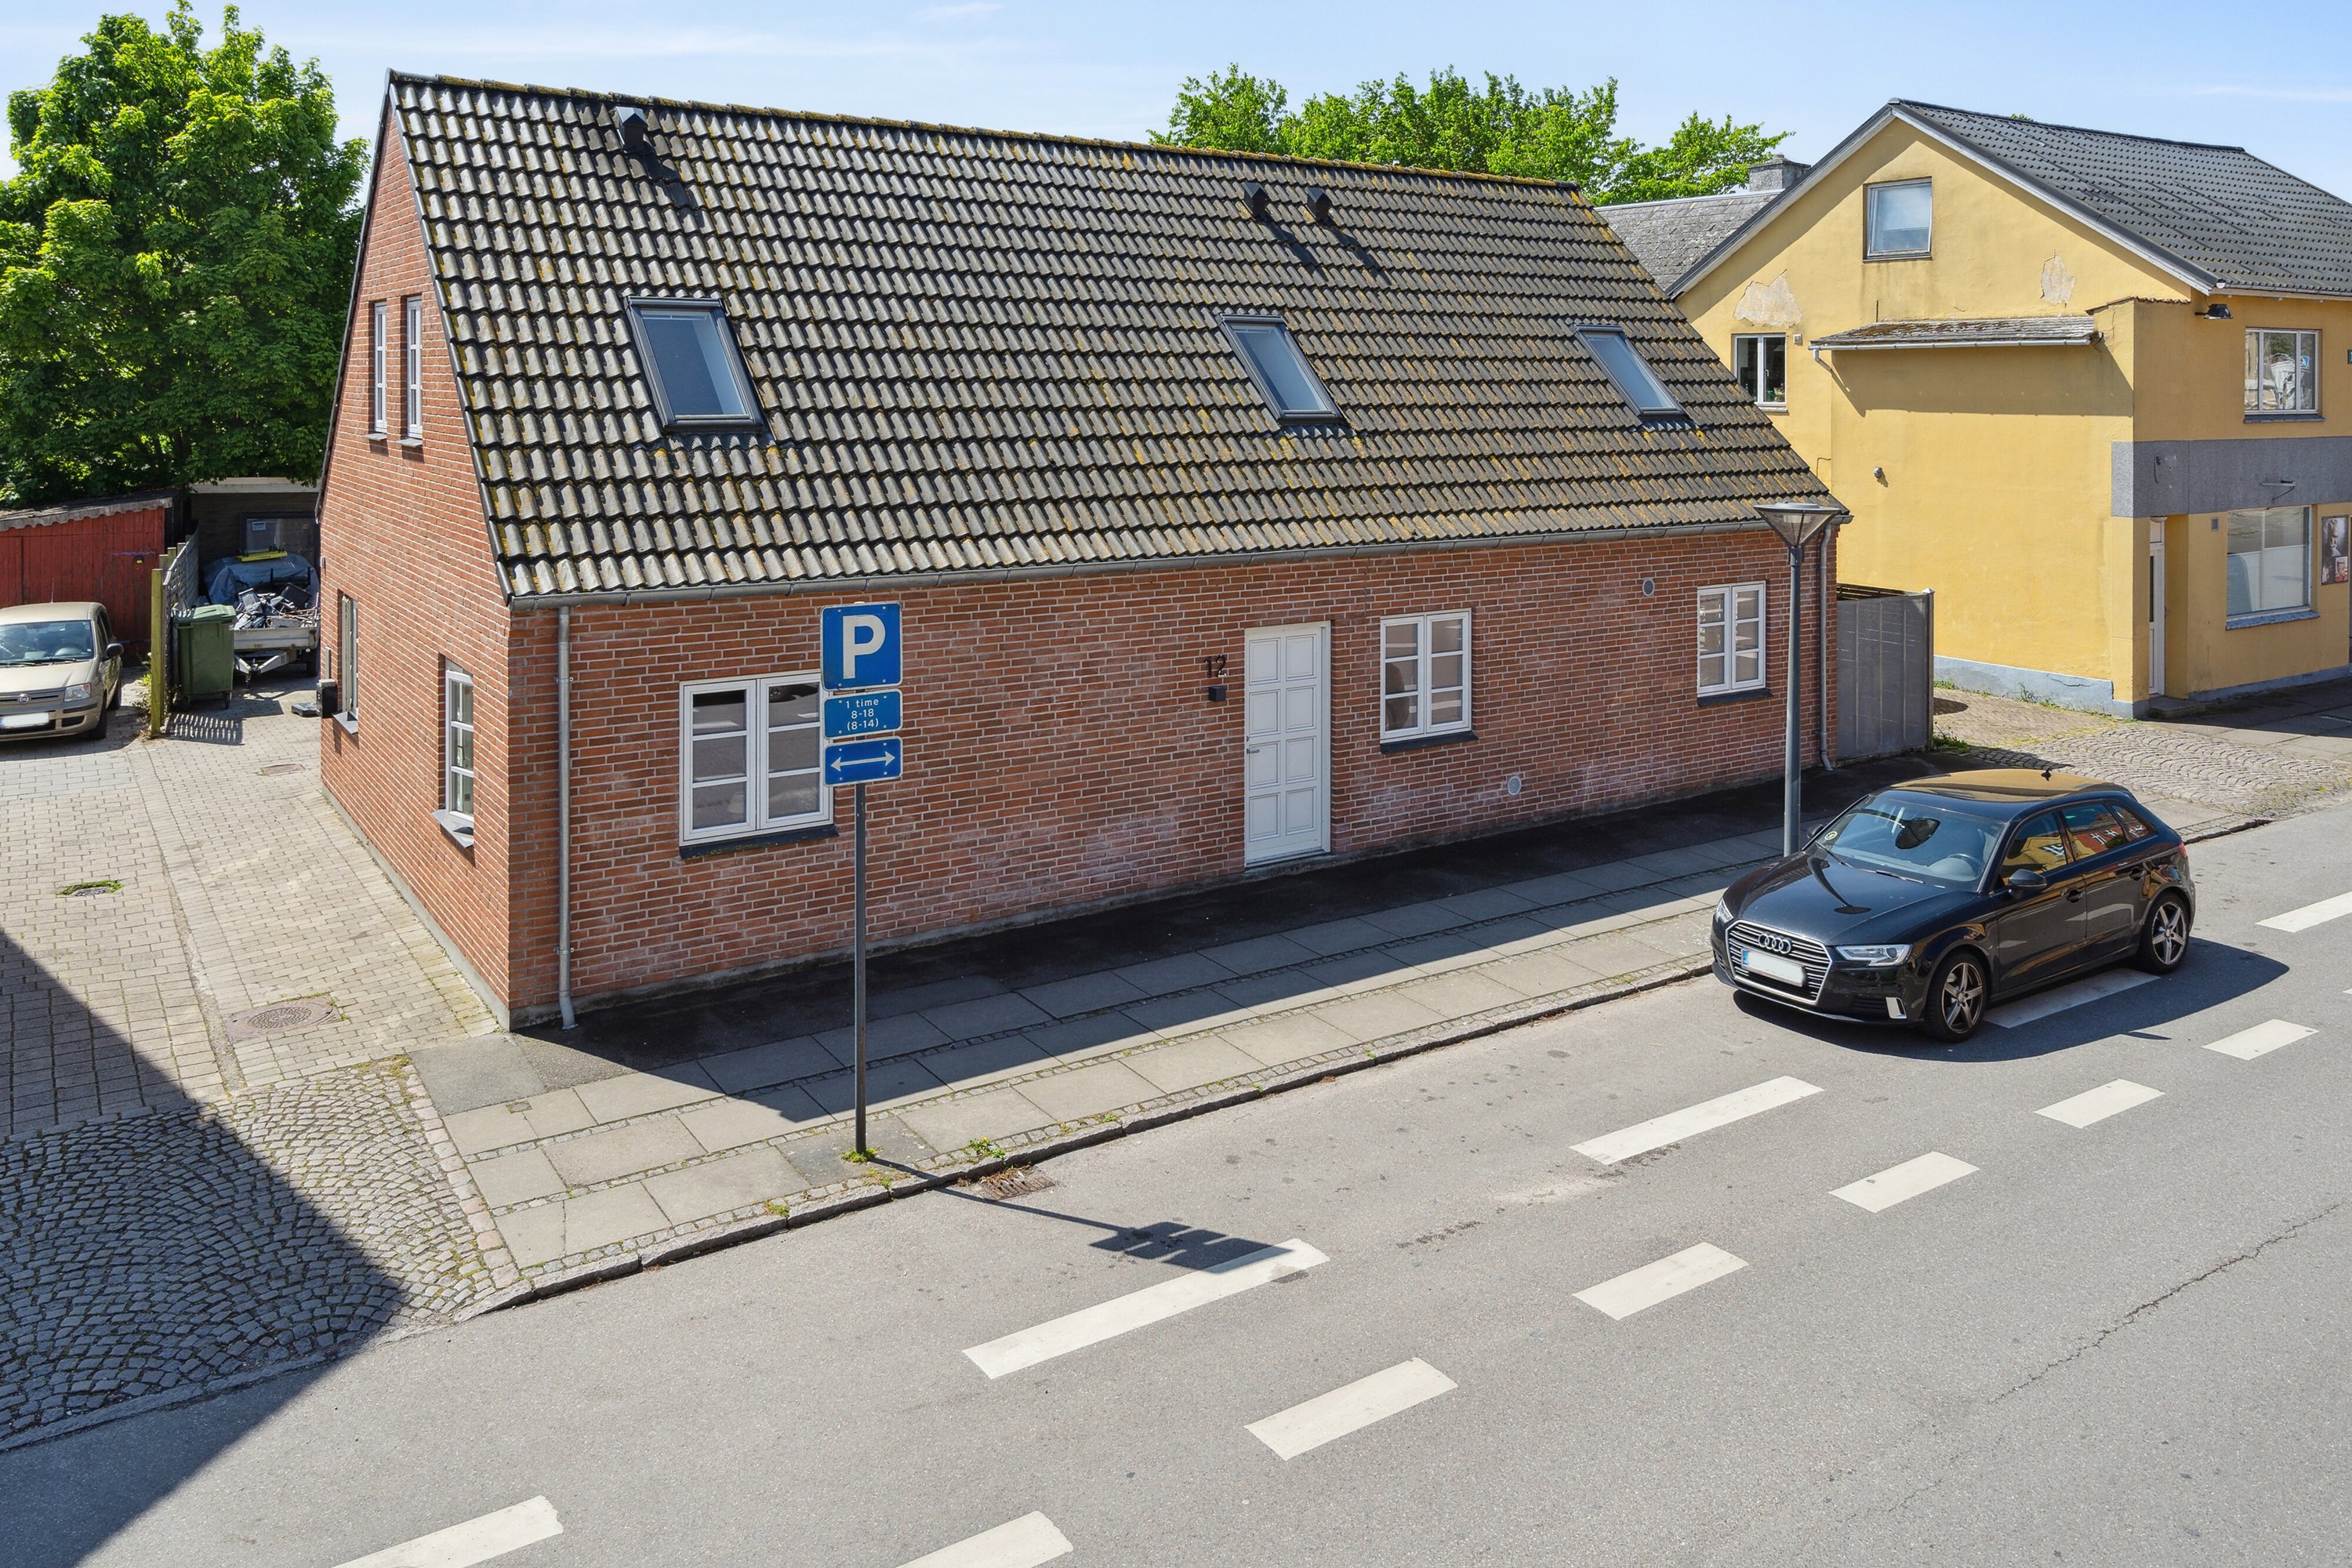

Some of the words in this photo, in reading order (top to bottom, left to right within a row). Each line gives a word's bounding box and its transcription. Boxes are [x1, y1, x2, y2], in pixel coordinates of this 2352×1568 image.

[842, 614, 886, 680] P
[1205, 654, 1227, 679] 12
[846, 700, 850, 709] 1
[855, 699, 879, 708] time
[851, 708, 874, 719] 8-18
[847, 717, 879, 731] (8-14)
